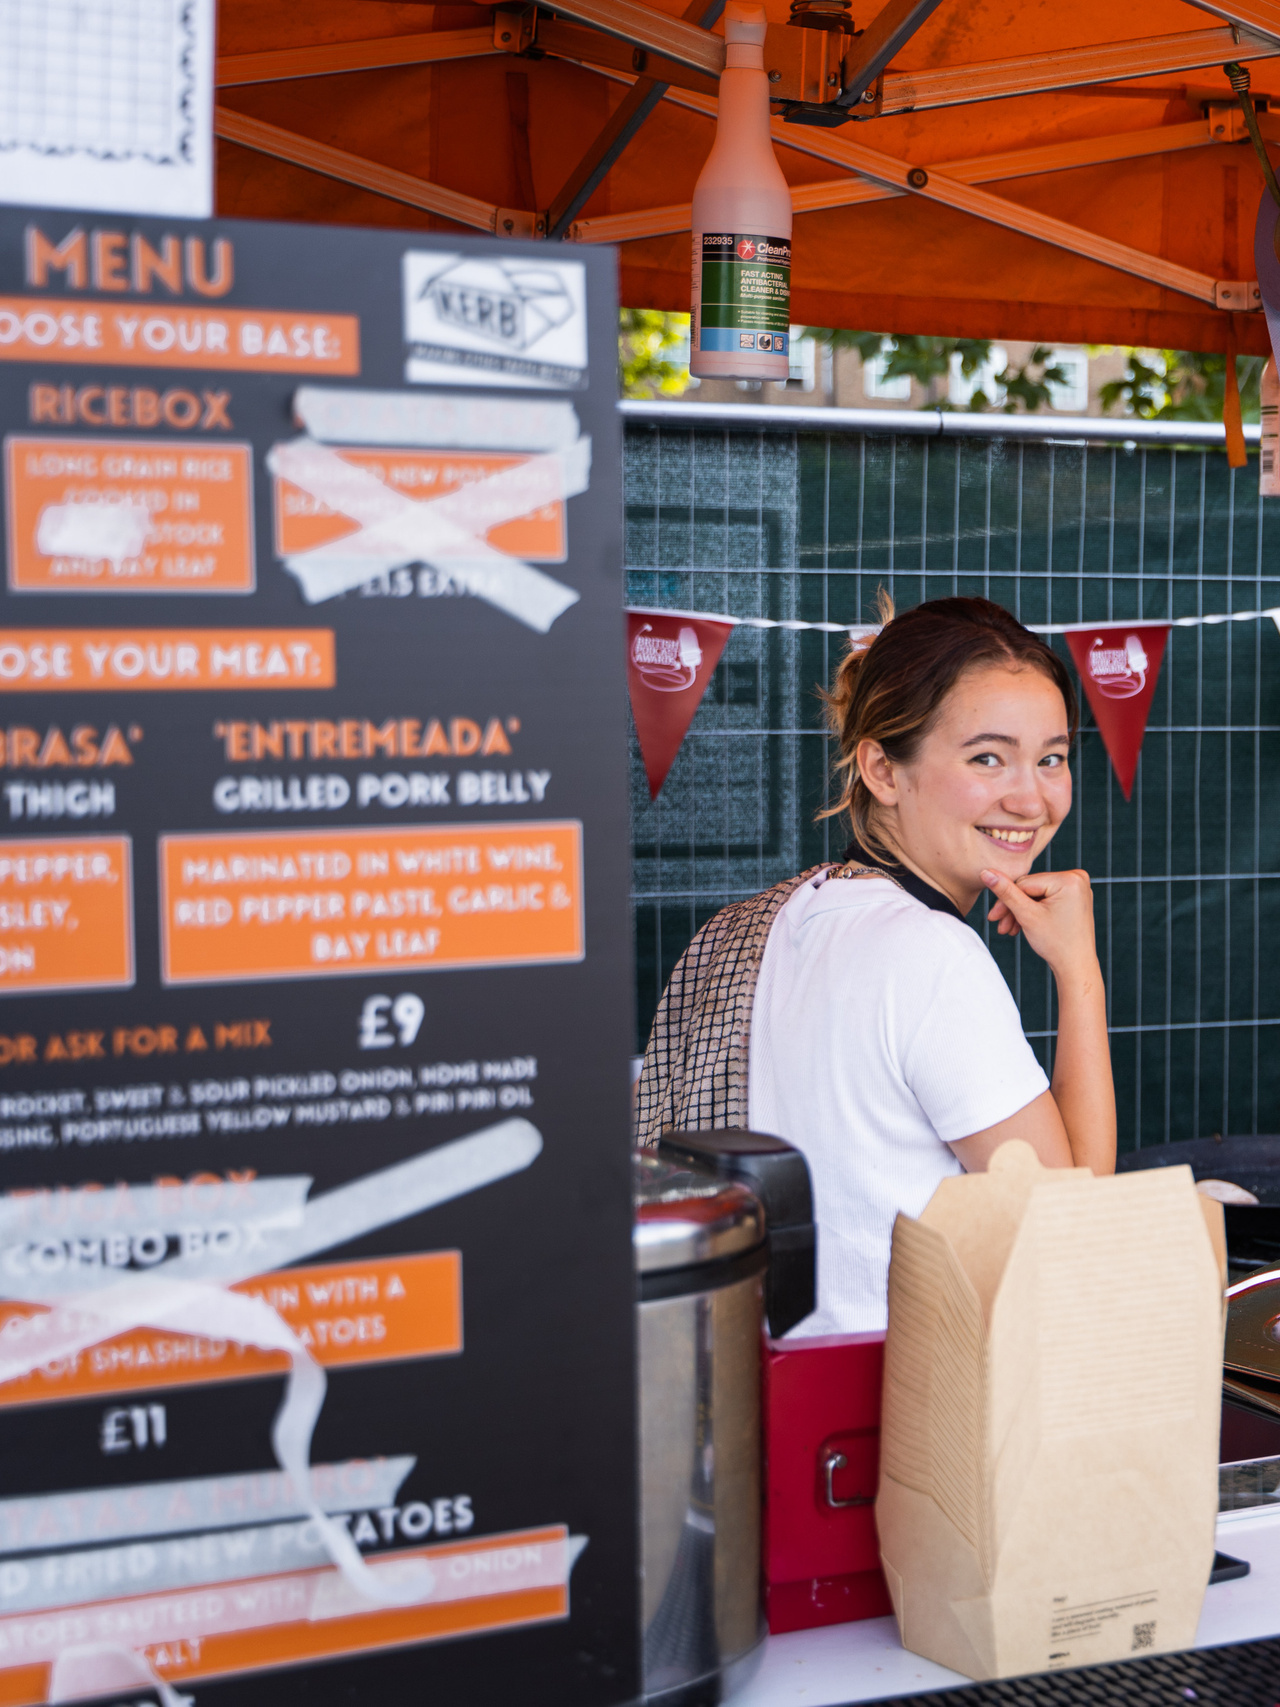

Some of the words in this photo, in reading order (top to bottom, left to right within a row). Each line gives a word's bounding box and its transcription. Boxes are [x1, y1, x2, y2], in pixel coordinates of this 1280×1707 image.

[26, 226, 233, 297] MENU
[703, 237, 733, 246] 232935
[741, 270, 759, 278] FAST
[760, 272, 783, 280] ACTING
[741, 278, 788, 289] ANTIBACTERIAL
[741, 285, 774, 294] CLEANER
[440, 288, 516, 340] KERB
[116, 316, 229, 352] YOUR
[240, 322, 340, 359] BASE:
[30, 384, 232, 430] RICEBOX
[27, 453, 98, 478] LONG
[102, 455, 177, 480] GRAIN
[181, 458, 232, 481] RICE
[171, 490, 201, 513] IN
[161, 552, 217, 578] LEAF
[0, 645, 72, 679] OSE
[84, 643, 199, 678] YOUR
[210, 644, 320, 678] MEAT:
[0, 725, 142, 768] RASA'
[5, 780, 115, 821] THIGH
[213, 773, 350, 813] GRILLED
[356, 770, 450, 808] PORK
[456, 769, 551, 806] BELLY
[182, 851, 351, 885] MARINATED
[357, 850, 388, 876] IN
[394, 846, 481, 875] WHITE
[487, 843, 563, 873] WINE,
[175, 897, 233, 927] RED
[240, 892, 344, 925] PEPPER
[351, 888, 443, 919] PASTE,
[447, 883, 544, 914] GARLIC
[311, 933, 371, 962] BAY
[377, 929, 440, 958] LEAF
[44, 1030, 105, 1060] ASK
[112, 1024, 178, 1055] FOR
[185, 1024, 208, 1051] A
[213, 1018, 272, 1048] MIX
[358, 993, 424, 1049] £9
[94, 1084, 163, 1111] SWEET
[189, 1077, 250, 1104] SOUR
[252, 1071, 336, 1099] PICKLED
[419, 1060, 479, 1087] HOME
[482, 1056, 537, 1082] MADE
[60, 1112, 200, 1145] PORTUGUESE
[204, 1102, 291, 1135] YELLOW
[294, 1096, 392, 1126] MUSTARD
[413, 1091, 454, 1115] PIRI
[457, 1087, 496, 1111] PIRI
[499, 1084, 533, 1109] OIL
[4, 1229, 168, 1278] COMBO
[307, 1276, 379, 1305] WITH
[387, 1275, 407, 1299] A
[93, 1340, 228, 1373] SMASHED
[102, 1405, 167, 1452] £11
[450, 1544, 543, 1579] ONION
